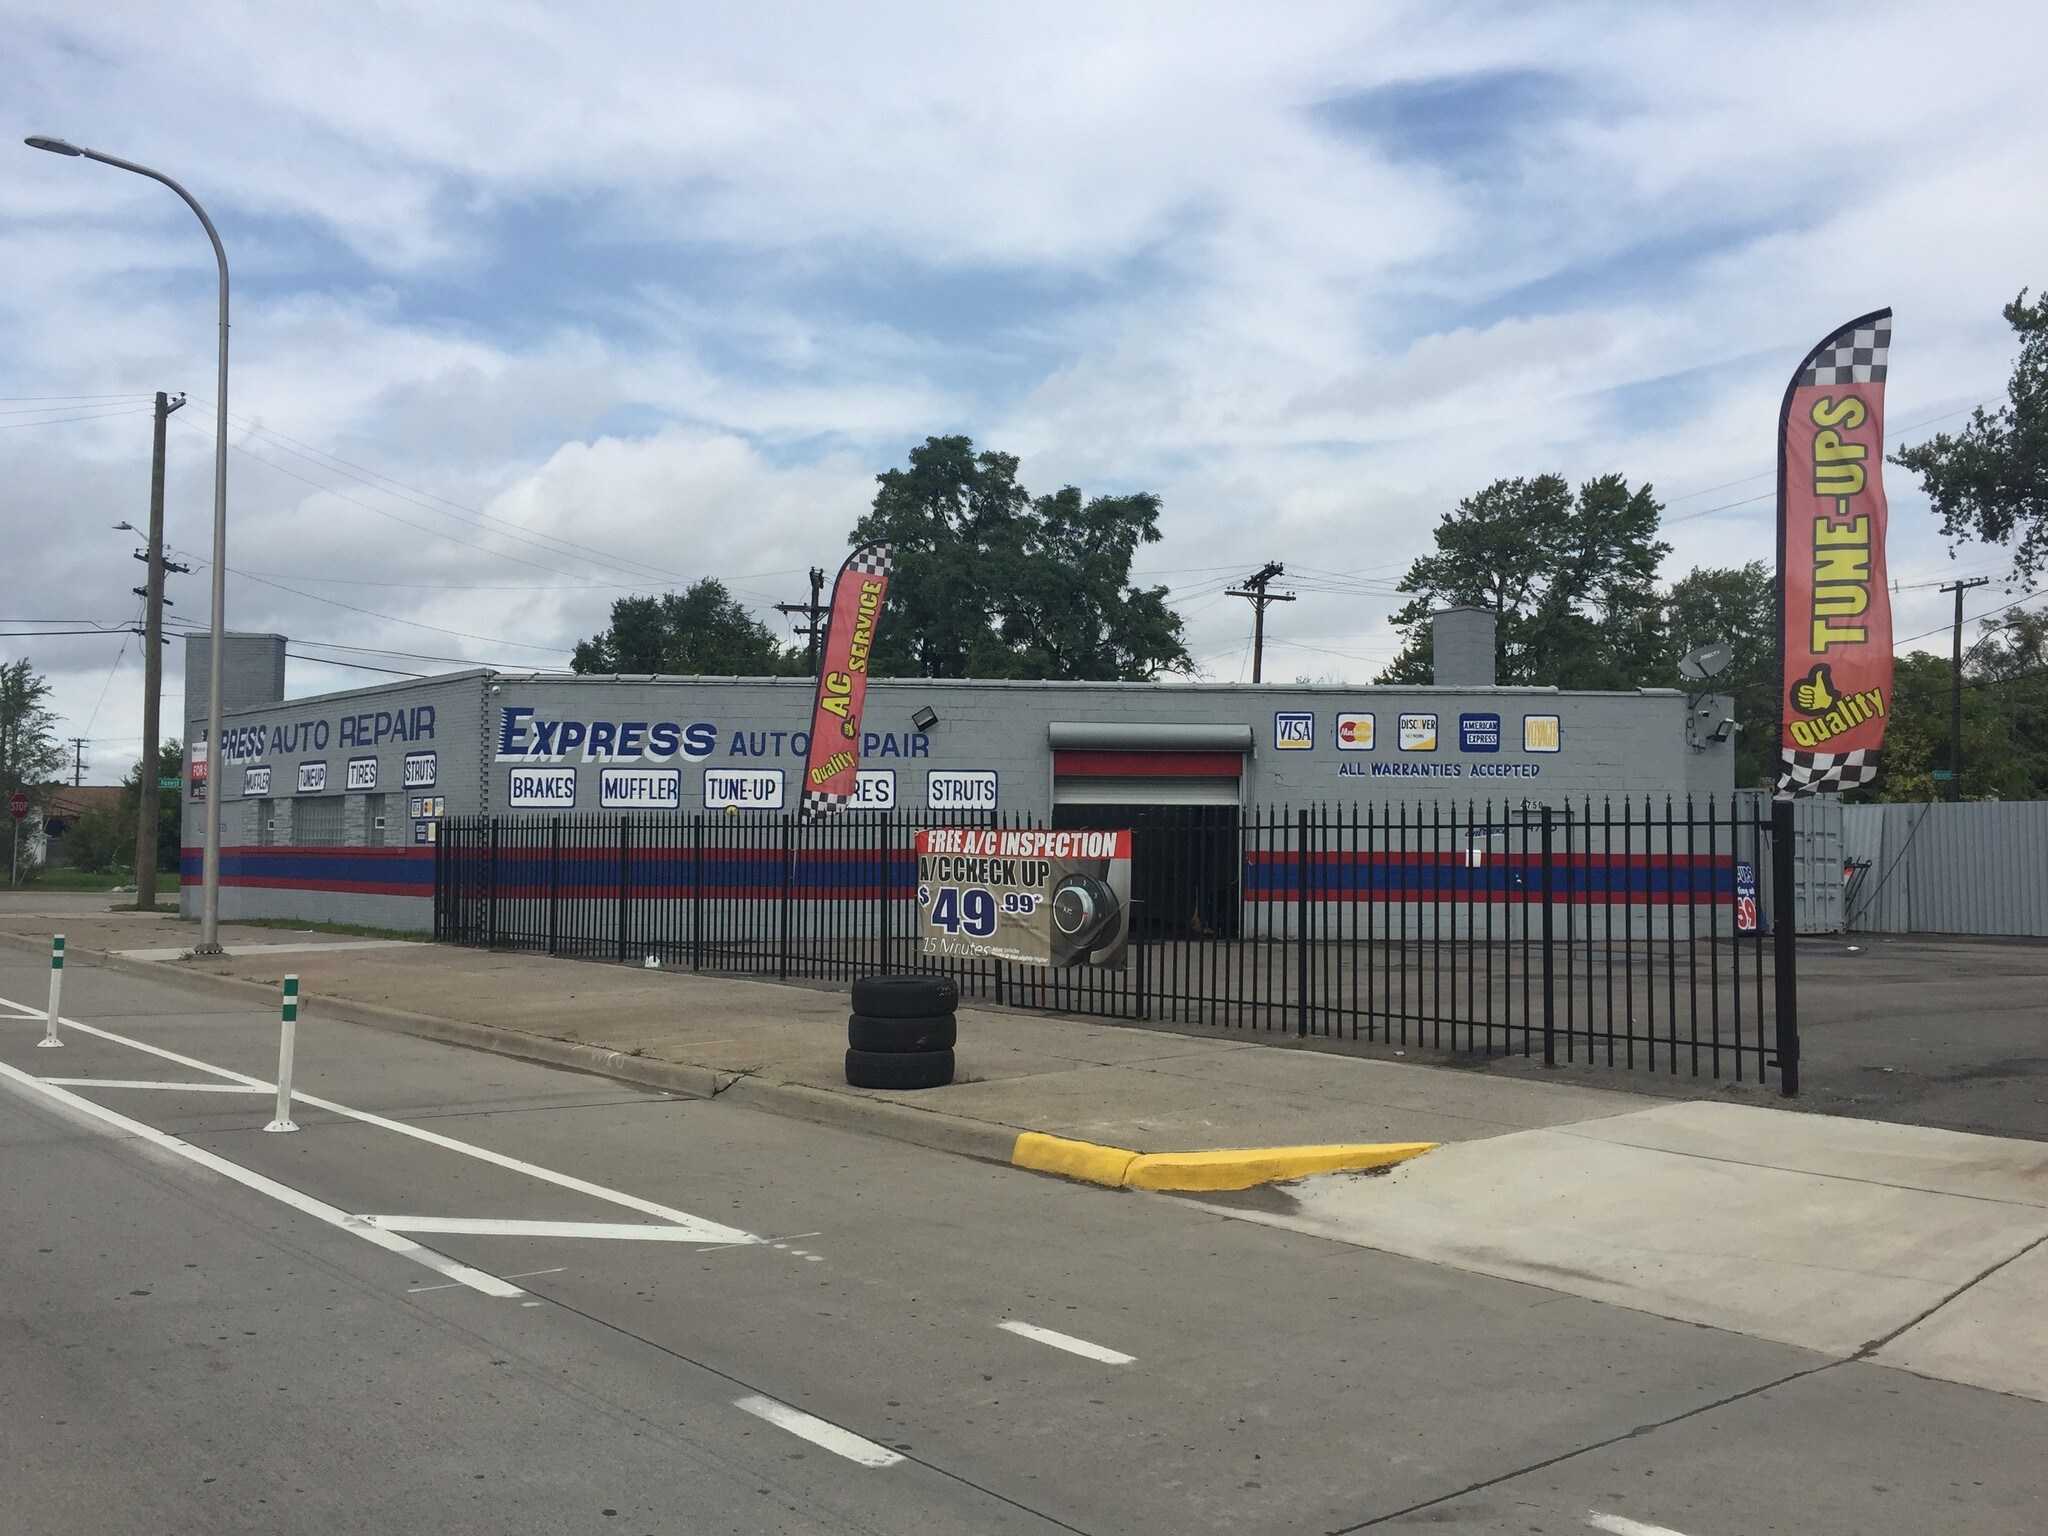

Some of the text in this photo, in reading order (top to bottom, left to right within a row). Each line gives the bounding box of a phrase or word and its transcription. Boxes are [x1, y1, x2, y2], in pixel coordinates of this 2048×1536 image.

[1809, 394, 1872, 655] TUNE-UPS
[848, 579, 884, 673] SERVICE
[821, 671, 851, 718] AC
[1401, 719, 1436, 730] DISCOVER
[1463, 721, 1497, 730] AMERICAN
[1789, 686, 1886, 748] Quality
[201, 705, 436, 765] PRESS AUTO REPAIR
[1279, 721, 1311, 741] VISA
[1468, 734, 1497, 744] EXPRESS
[729, 731, 810, 757] AUTO
[857, 732, 930, 758] PAIR
[350, 763, 376, 785] TIRES
[405, 758, 435, 781] STRUTS
[811, 750, 856, 785] Quality
[1338, 763, 1540, 778] ALL WARRANTIES ACCEPTED
[245, 772, 270, 791] MUFFLER
[513, 777, 573, 799] BRAKES
[604, 777, 677, 800] MUFFLER
[708, 778, 776, 801] TUNE-UP
[851, 779, 889, 802] RES
[932, 779, 994, 801] STRUTS
[11, 800, 29, 812] STOP
[927, 830, 1117, 858] FREE A/C INSPECTION
[919, 856, 1050, 887] A/C CHECK UP
[922, 937, 938, 952] 15
